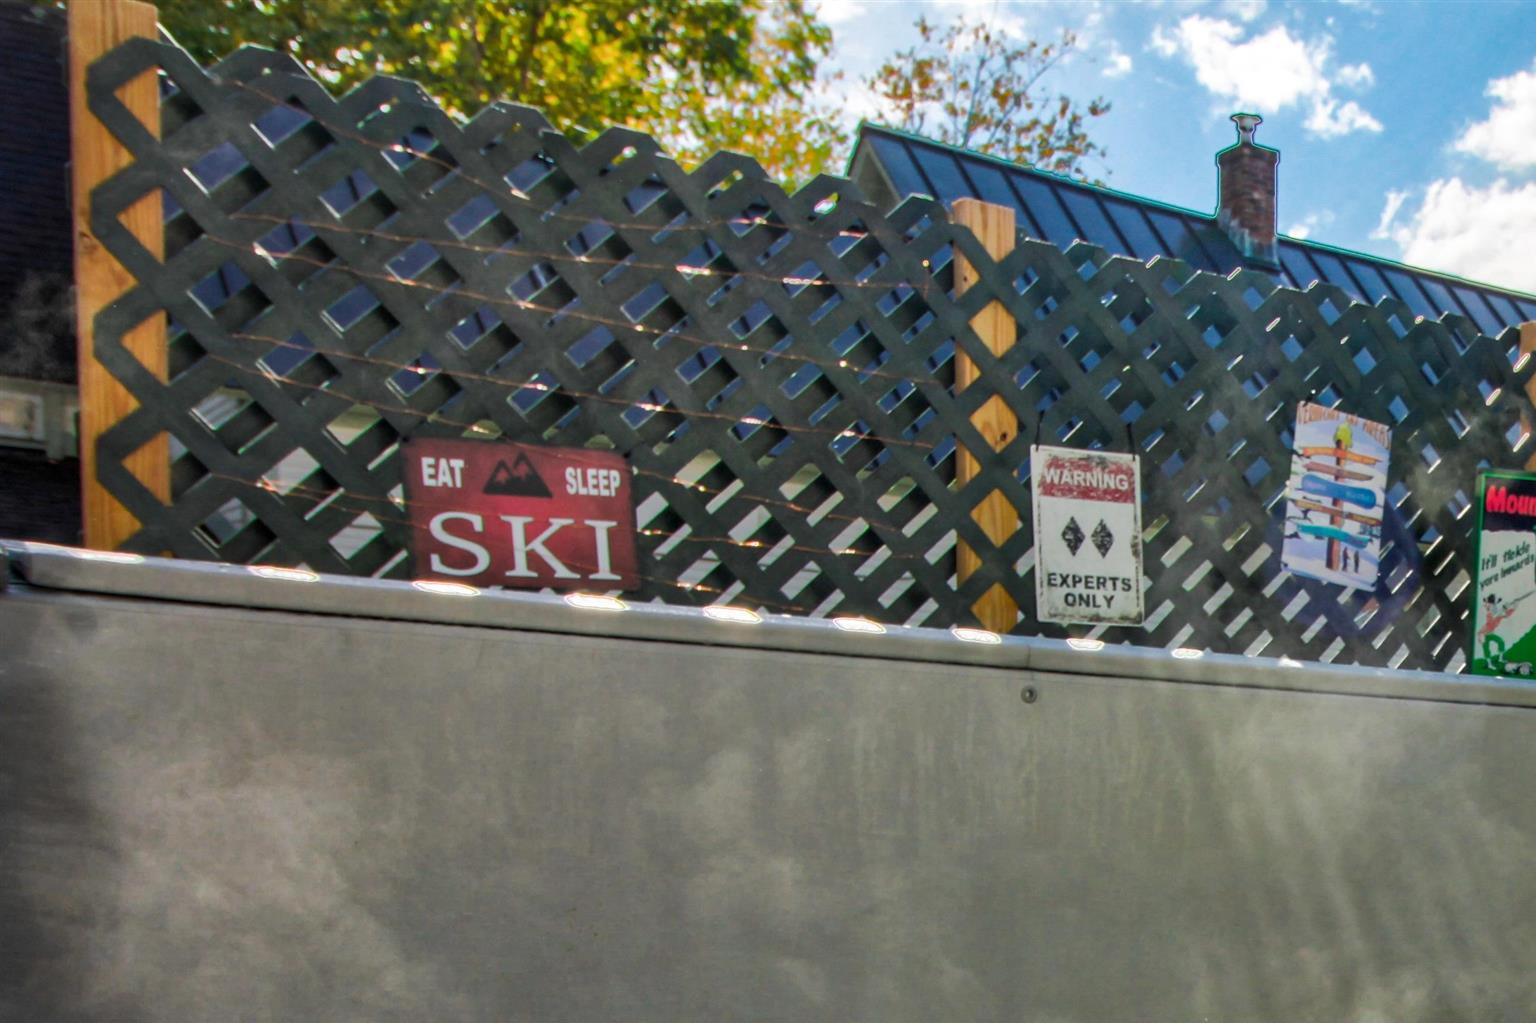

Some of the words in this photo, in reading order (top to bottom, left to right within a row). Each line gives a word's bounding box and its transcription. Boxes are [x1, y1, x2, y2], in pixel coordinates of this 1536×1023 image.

[421, 457, 465, 488] EAT
[565, 467, 621, 497] SLEEP
[1043, 467, 1129, 491] WARNING
[429, 511, 622, 581] SKI
[1047, 572, 1132, 592] EXPERTS
[1064, 593, 1115, 609] ONLY
